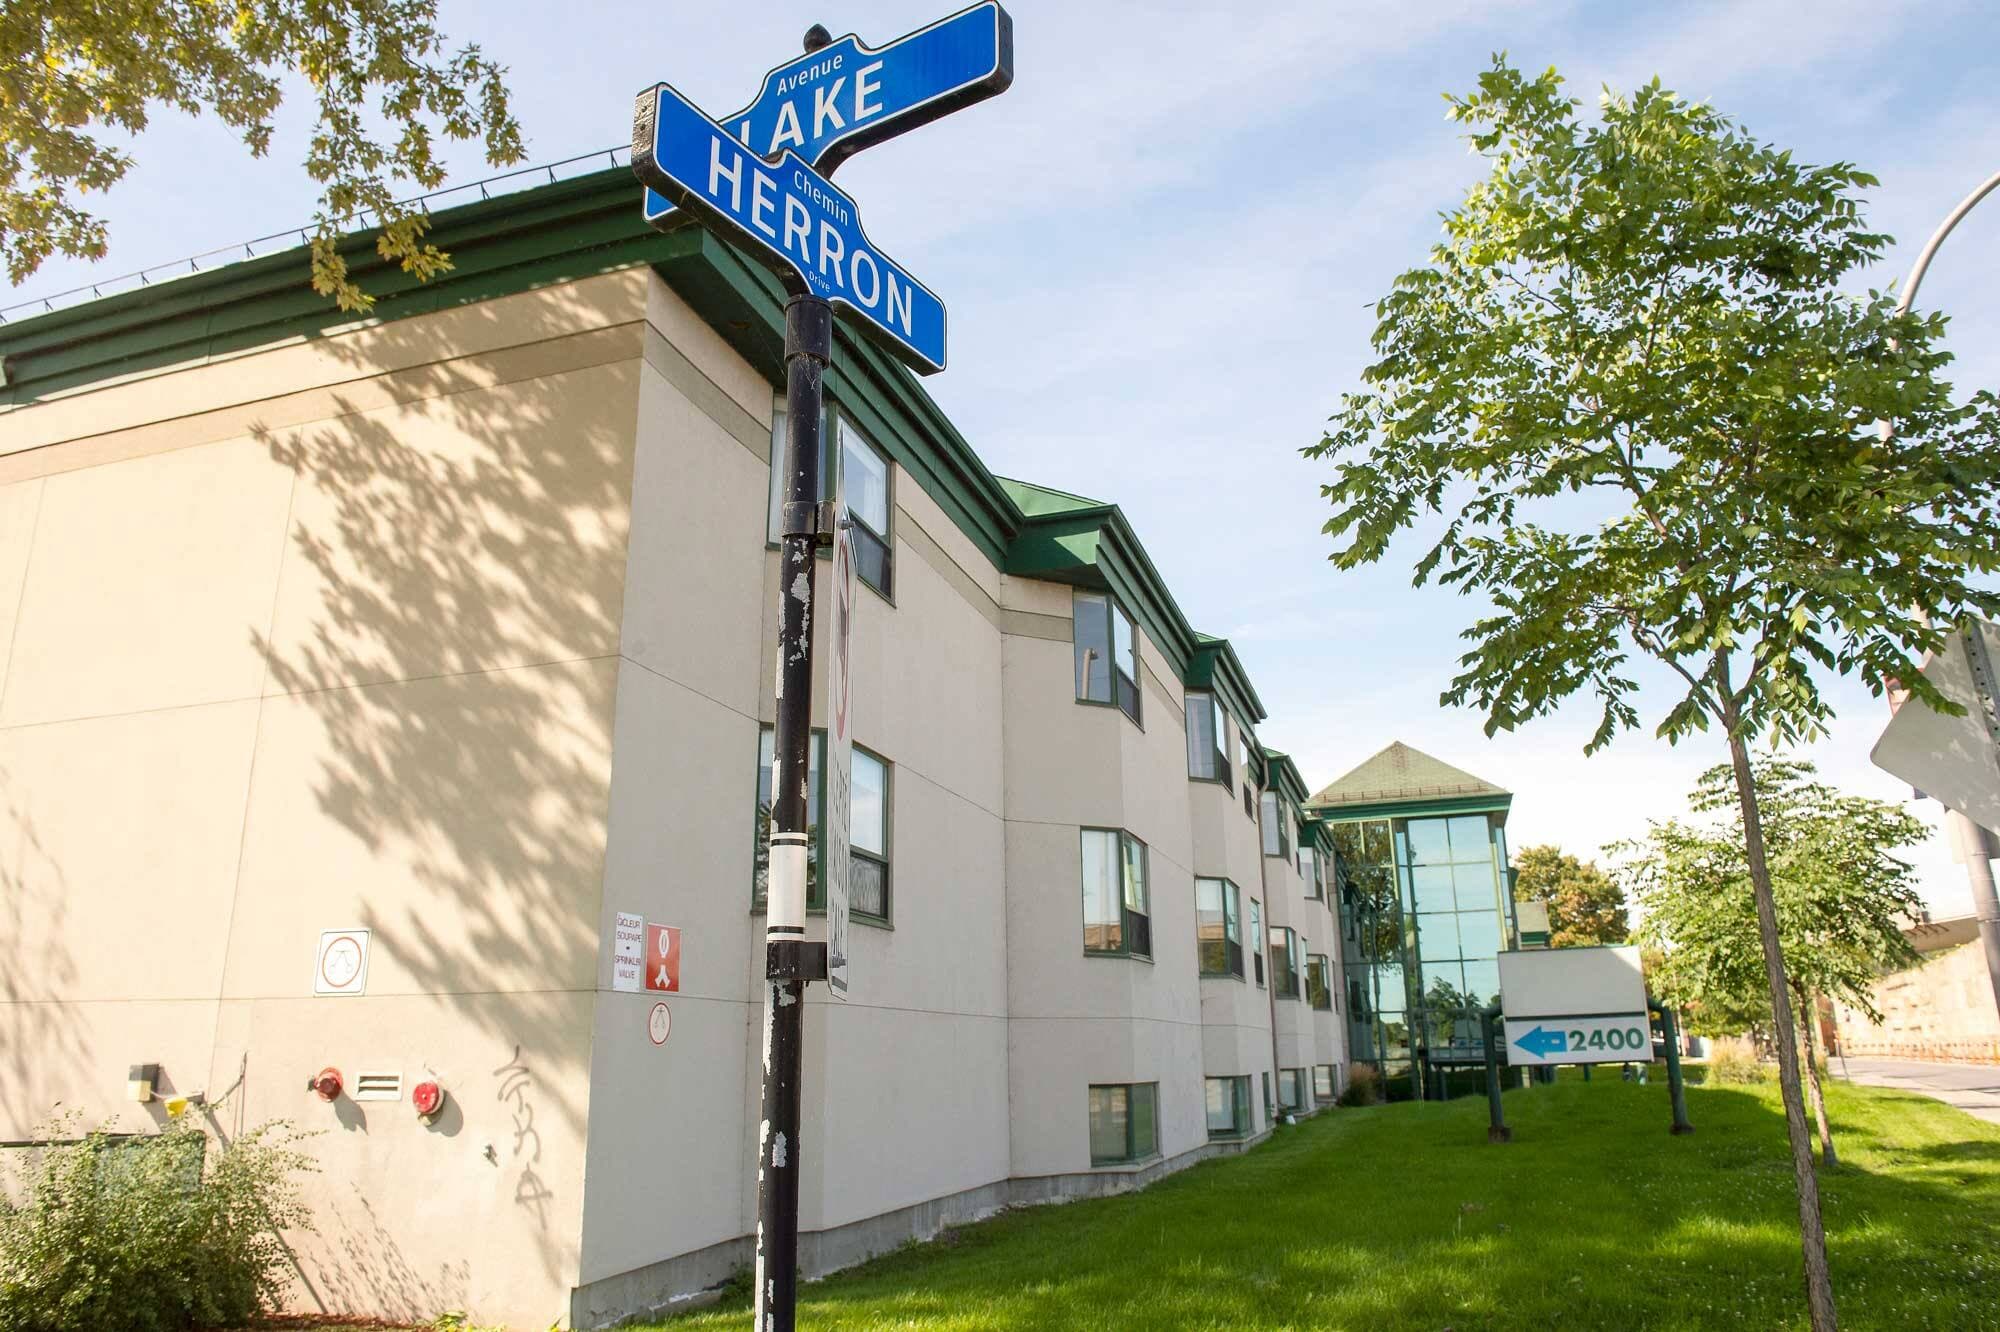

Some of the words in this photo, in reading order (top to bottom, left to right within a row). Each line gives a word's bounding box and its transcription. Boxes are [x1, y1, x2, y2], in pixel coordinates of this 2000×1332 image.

[777, 54, 844, 97] Avenue
[794, 170, 849, 226] Chemin
[708, 135, 913, 337] HERRON
[808, 270, 831, 293] Drive
[1568, 1027, 1644, 1051] 2400
